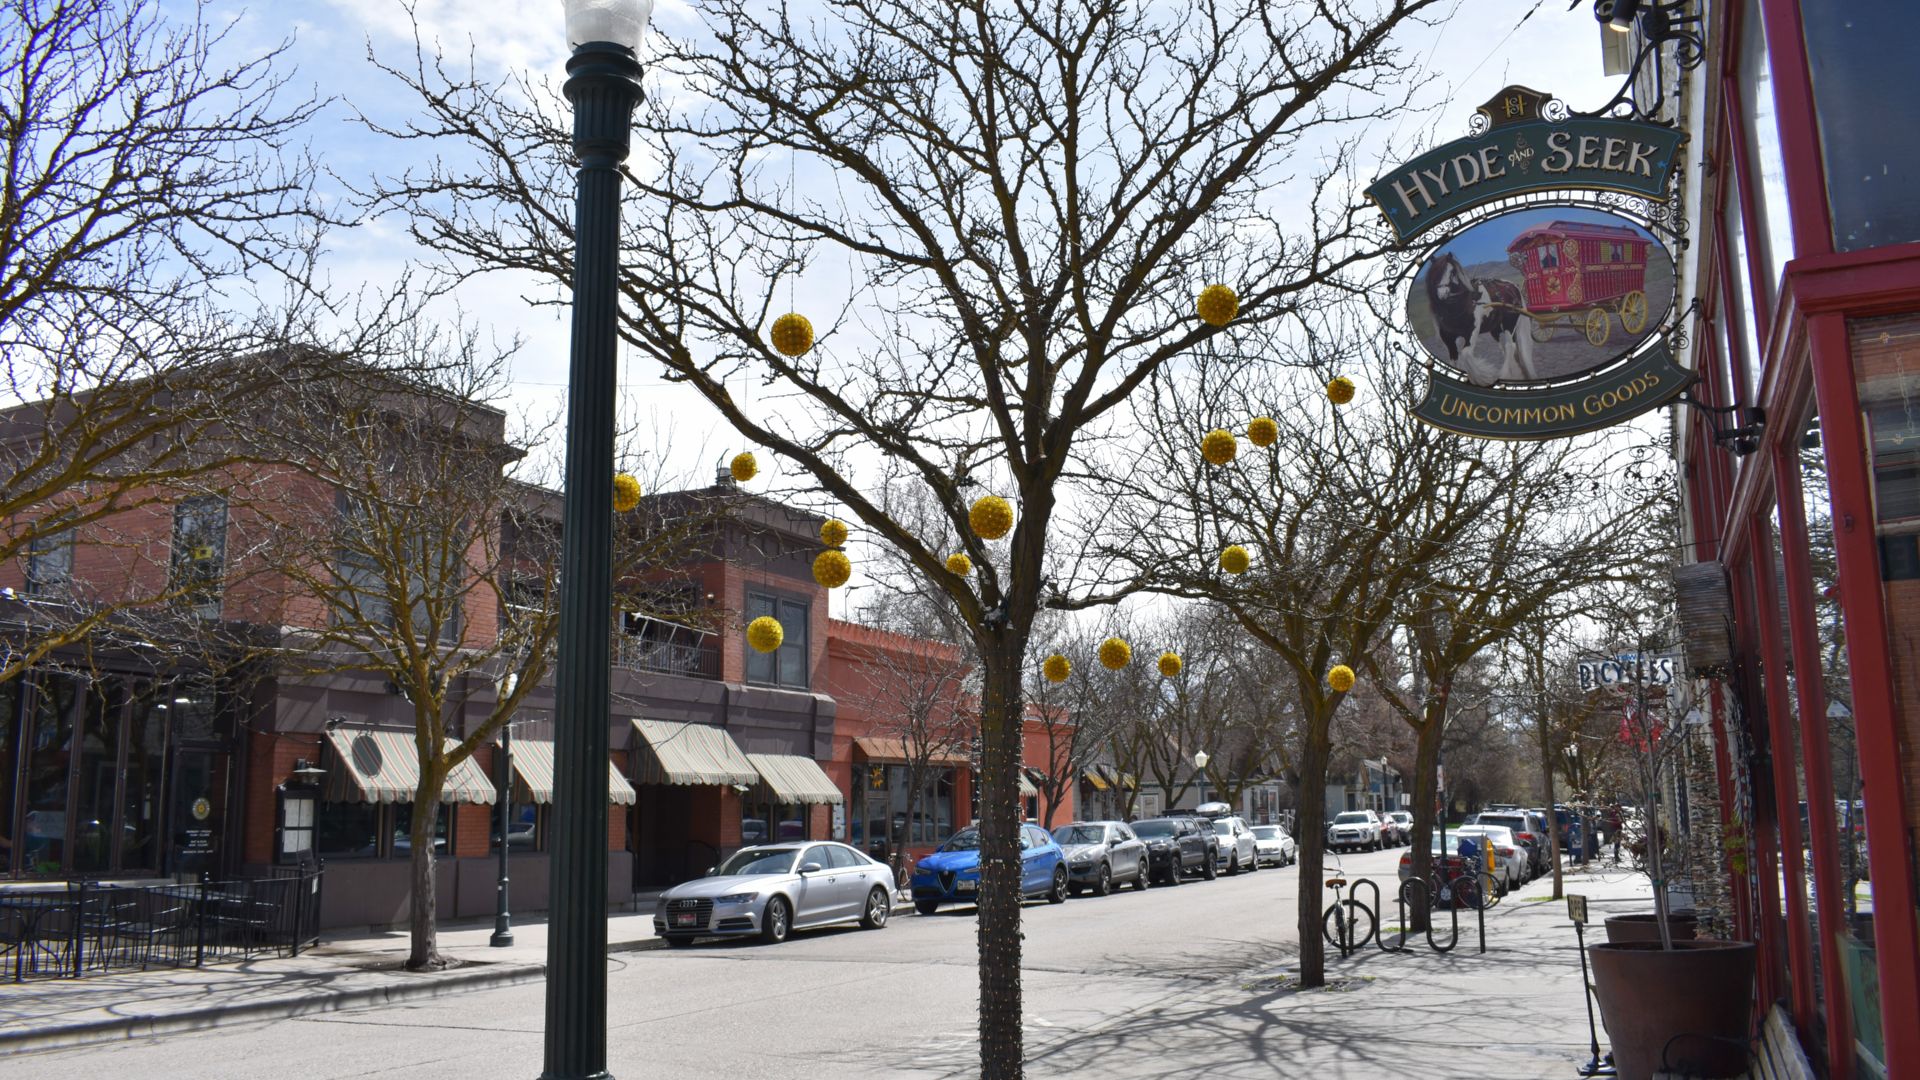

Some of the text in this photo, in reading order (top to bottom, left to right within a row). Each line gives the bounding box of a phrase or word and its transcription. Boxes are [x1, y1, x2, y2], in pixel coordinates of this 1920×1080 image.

[1390, 144, 1506, 219] HYDE
[1541, 132, 1660, 178] SEEK
[1440, 370, 1661, 425] UNCOMMON GOODS
